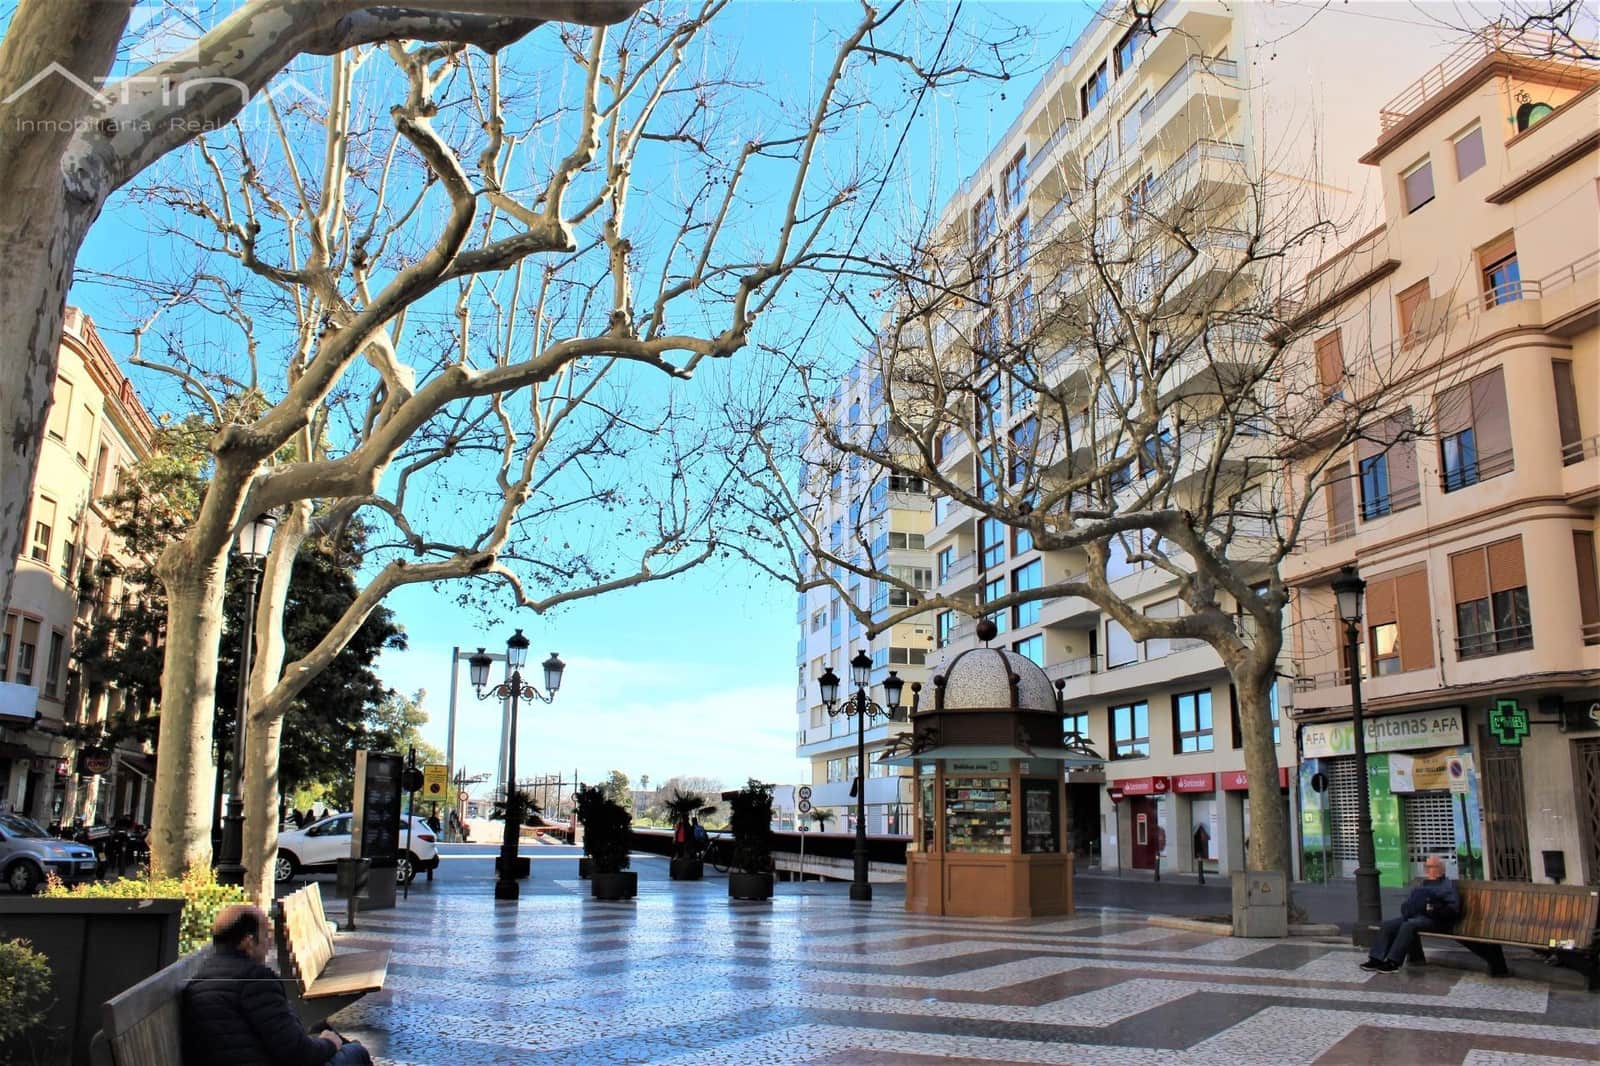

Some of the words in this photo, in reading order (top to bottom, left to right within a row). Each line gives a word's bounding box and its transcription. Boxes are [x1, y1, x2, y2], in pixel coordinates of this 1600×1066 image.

[1364, 717, 1428, 738] entanas
[1432, 717, 1460, 734] AFA
[1305, 733, 1327, 746] AFA
